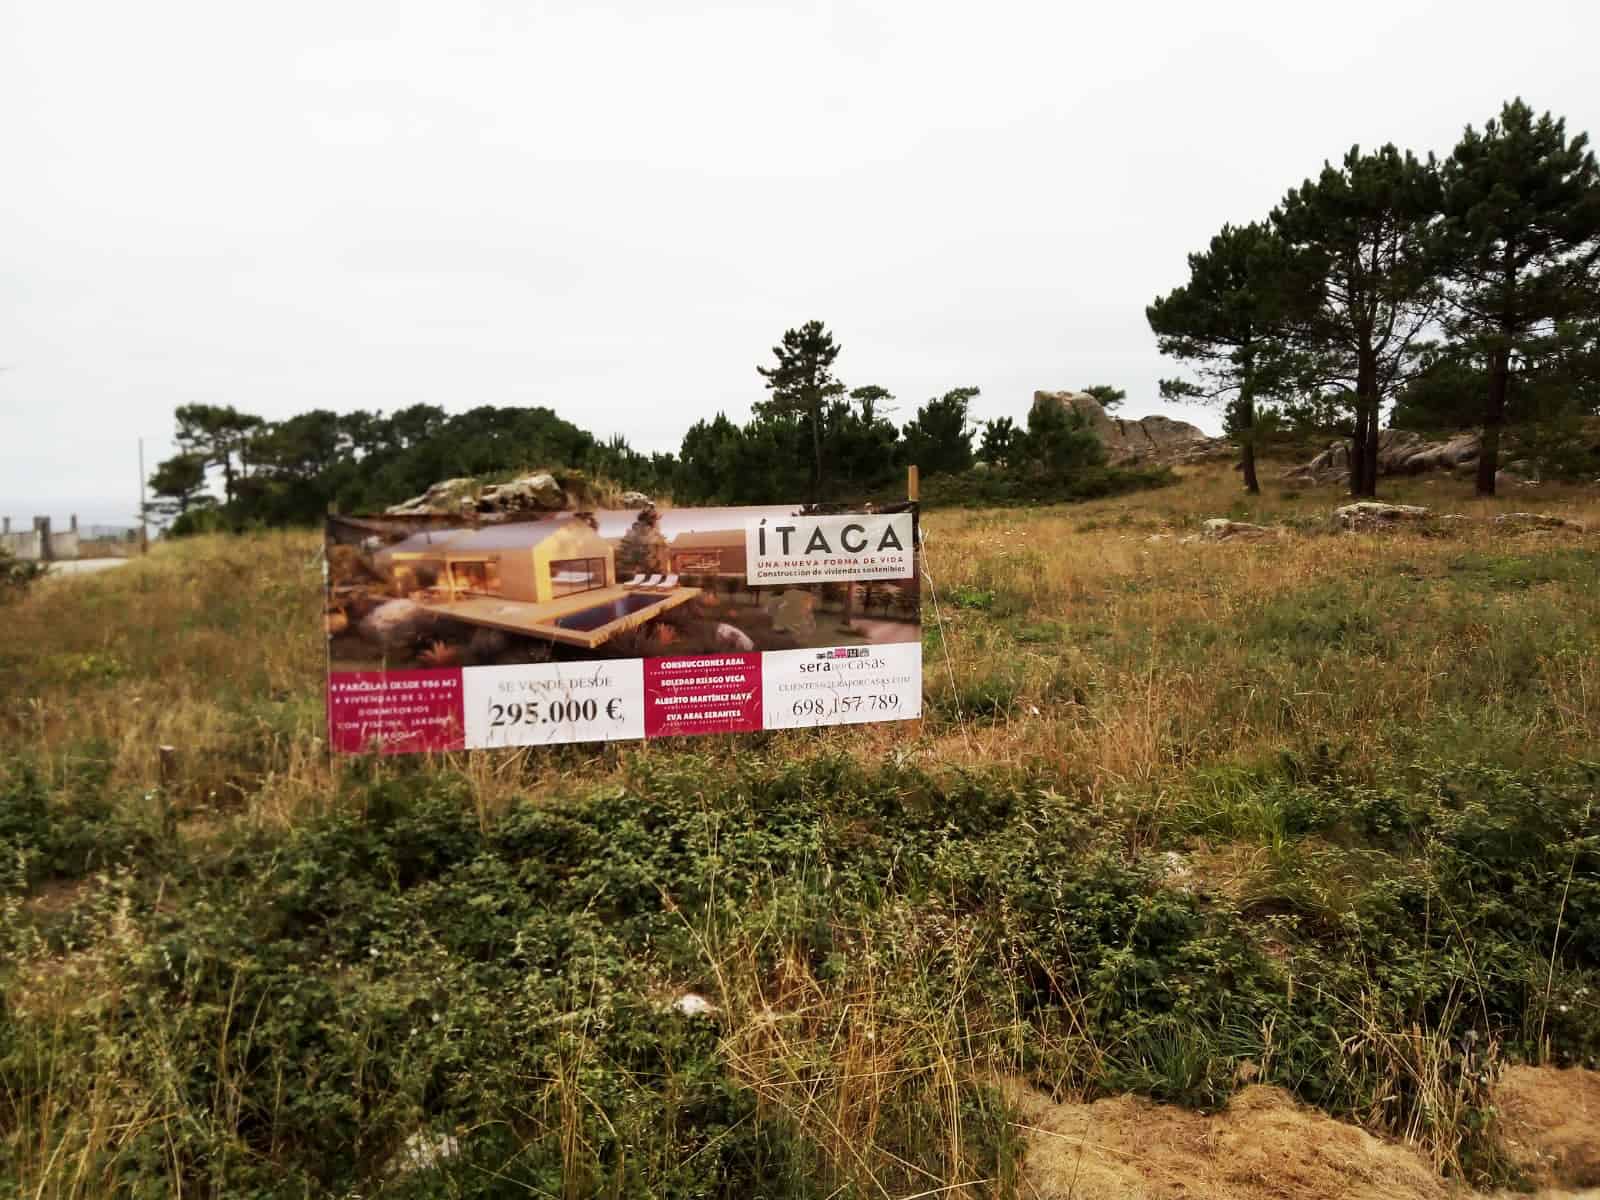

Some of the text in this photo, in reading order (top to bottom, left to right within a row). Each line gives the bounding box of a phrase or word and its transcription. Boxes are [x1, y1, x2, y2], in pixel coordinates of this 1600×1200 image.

[759, 518, 904, 556] ÍTACA
[757, 561, 779, 569] UNA
[784, 559, 819, 567] NUEVA
[823, 558, 859, 566] FORMA
[812, 568, 822, 576] de
[824, 567, 860, 576] viviendas
[862, 565, 905, 574] sostenibles
[339, 681, 388, 691] PARCELAS
[390, 680, 420, 689] DESDE
[498, 677, 613, 692] SE VENDE DESDE
[661, 678, 695, 687] SOLEDAD
[655, 695, 689, 705] ALBERTO
[792, 693, 899, 716] 698 157 789
[490, 697, 623, 727] 295.000 €
[666, 713, 682, 721] EVA
[704, 710, 741, 718] SERANTES
